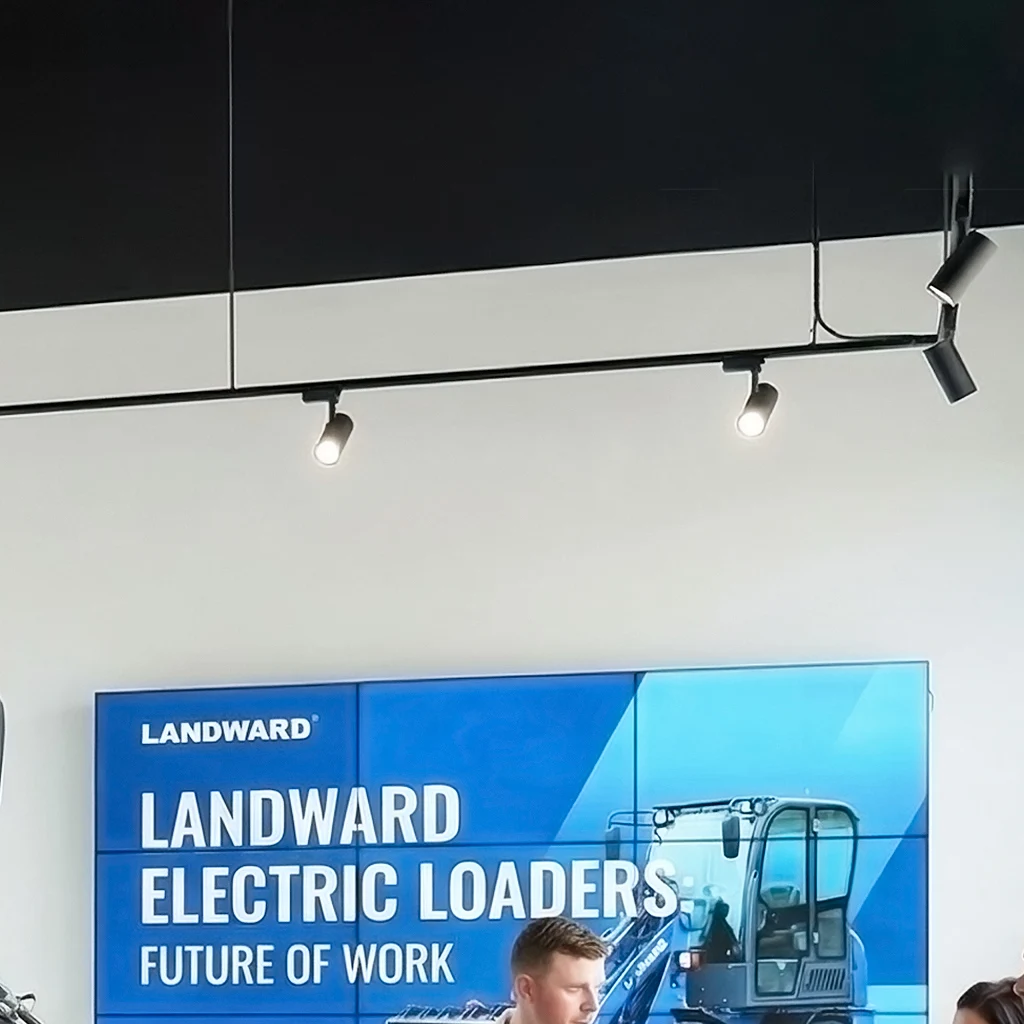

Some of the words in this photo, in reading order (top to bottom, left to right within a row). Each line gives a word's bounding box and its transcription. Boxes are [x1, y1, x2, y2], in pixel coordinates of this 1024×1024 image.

[141, 784, 461, 849] LANDWARD
[141, 862, 398, 925] ELECTRIC
[419, 859, 678, 920] LOADERS
[140, 944, 275, 986] FUTURE
[286, 943, 332, 985] OF
[342, 942, 455, 985] WORK
